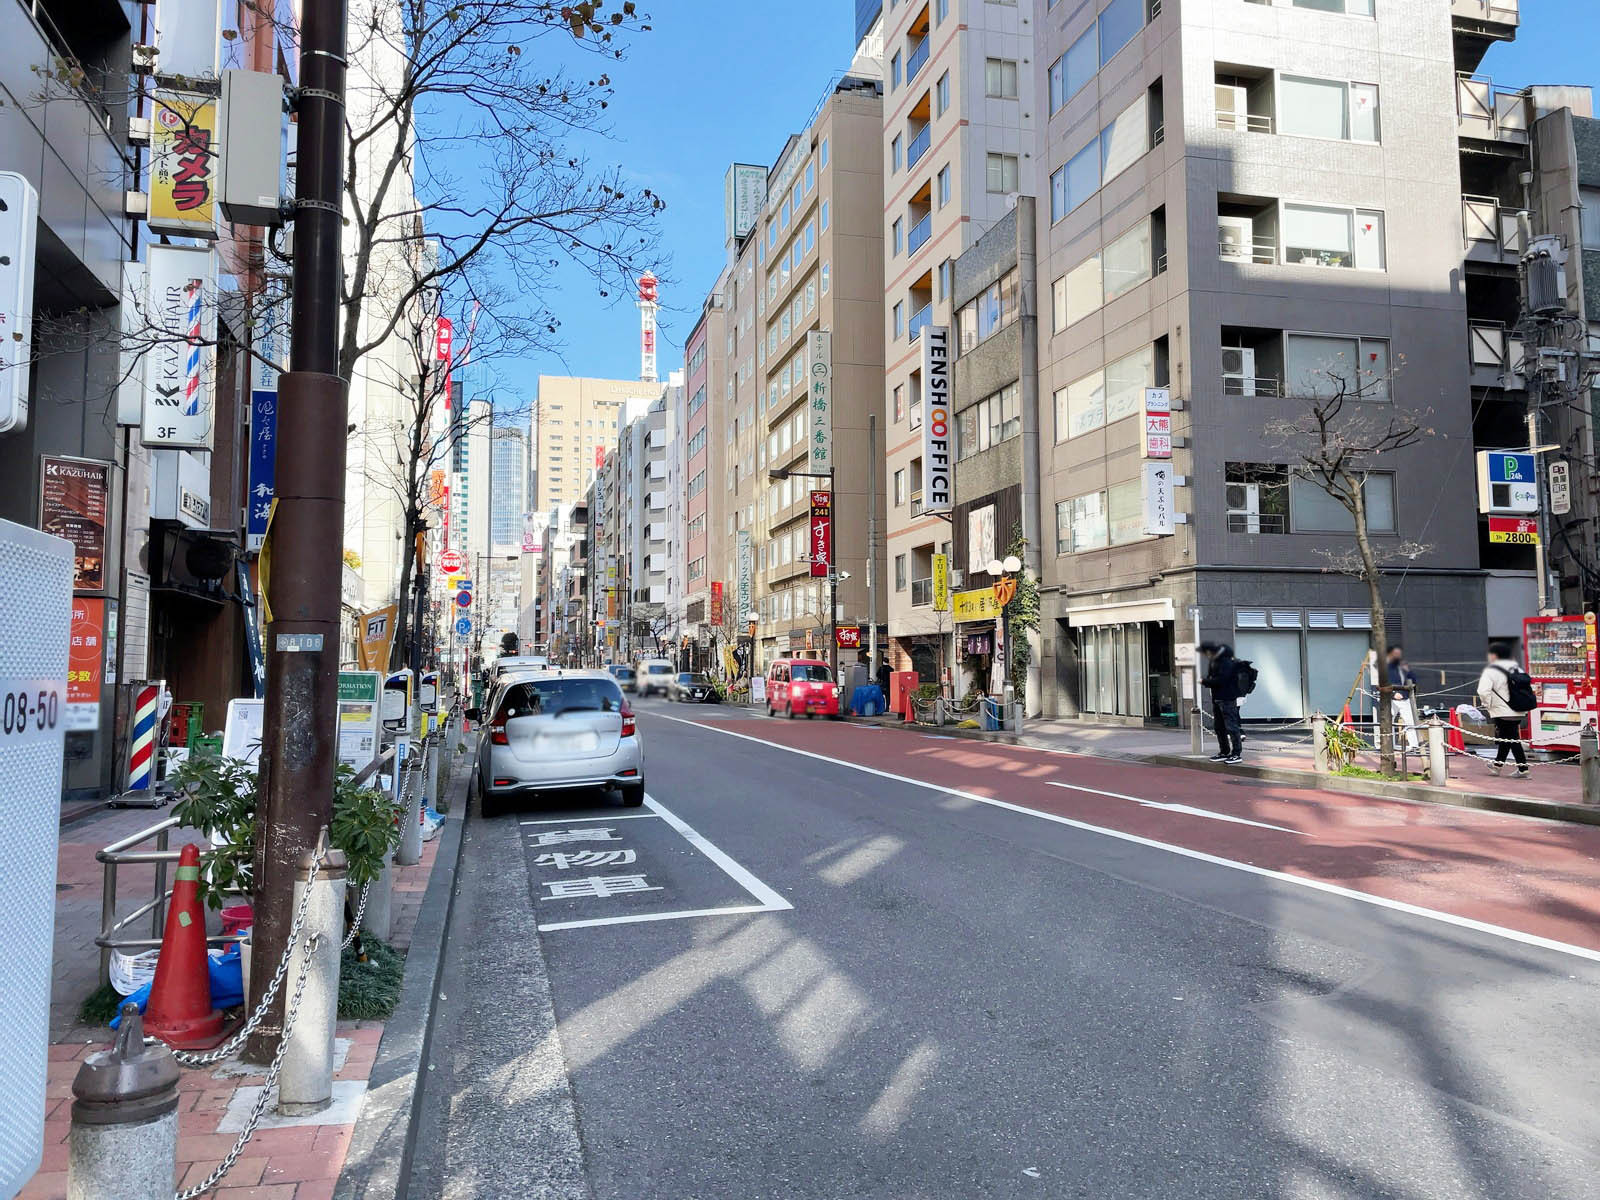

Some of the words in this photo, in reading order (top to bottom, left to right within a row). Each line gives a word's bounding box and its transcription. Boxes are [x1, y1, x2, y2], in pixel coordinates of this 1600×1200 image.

[164, 286, 181, 379] KAZHAIR
[813, 381, 828, 461] 新橋三番館
[1148, 419, 1169, 431] 大熊
[157, 427, 177, 438] 3F
[1149, 437, 1169, 450] 歯科
[1504, 456, 1519, 480] P
[813, 520, 829, 567] すき家
[1505, 532, 1531, 543] 2800
[71, 636, 97, 646] 店舗
[4, 691, 58, 735] 08-50
